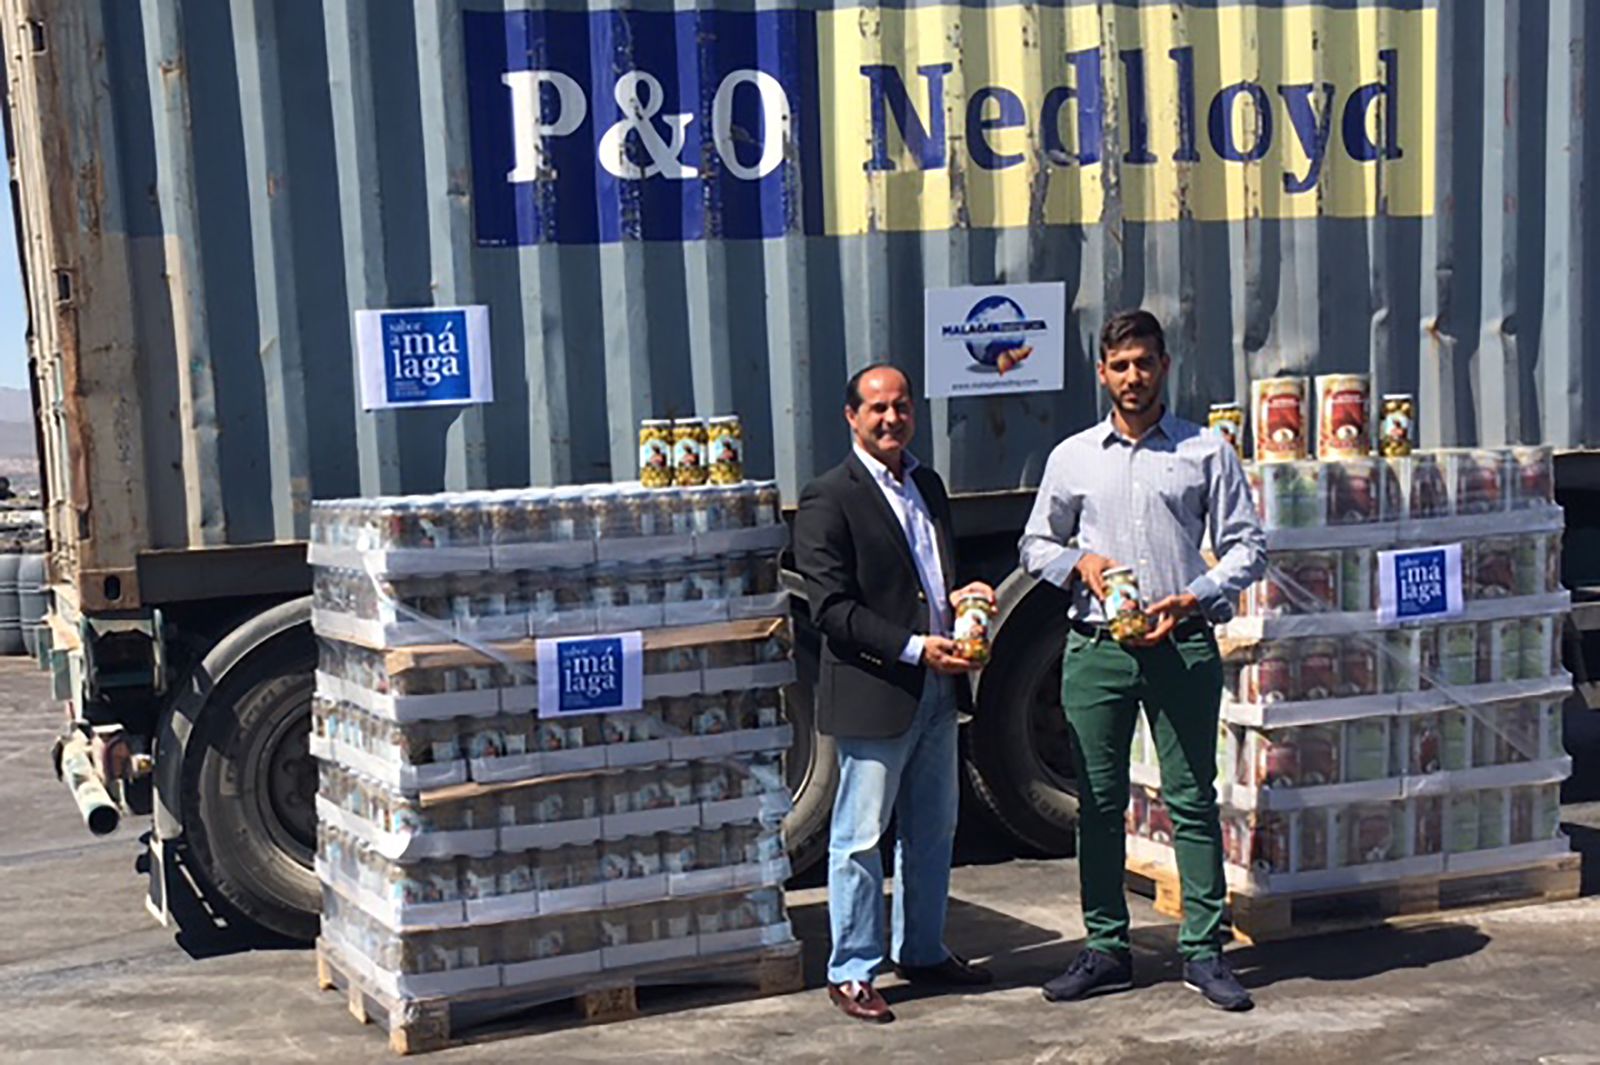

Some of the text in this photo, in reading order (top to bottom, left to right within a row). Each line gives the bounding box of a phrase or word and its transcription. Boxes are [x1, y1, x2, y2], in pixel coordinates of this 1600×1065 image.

[501, 46, 1403, 194] P&O Nedlloyd
[393, 349, 460, 386] laga
[1401, 579, 1441, 605] laga
[565, 669, 616, 698] laga
